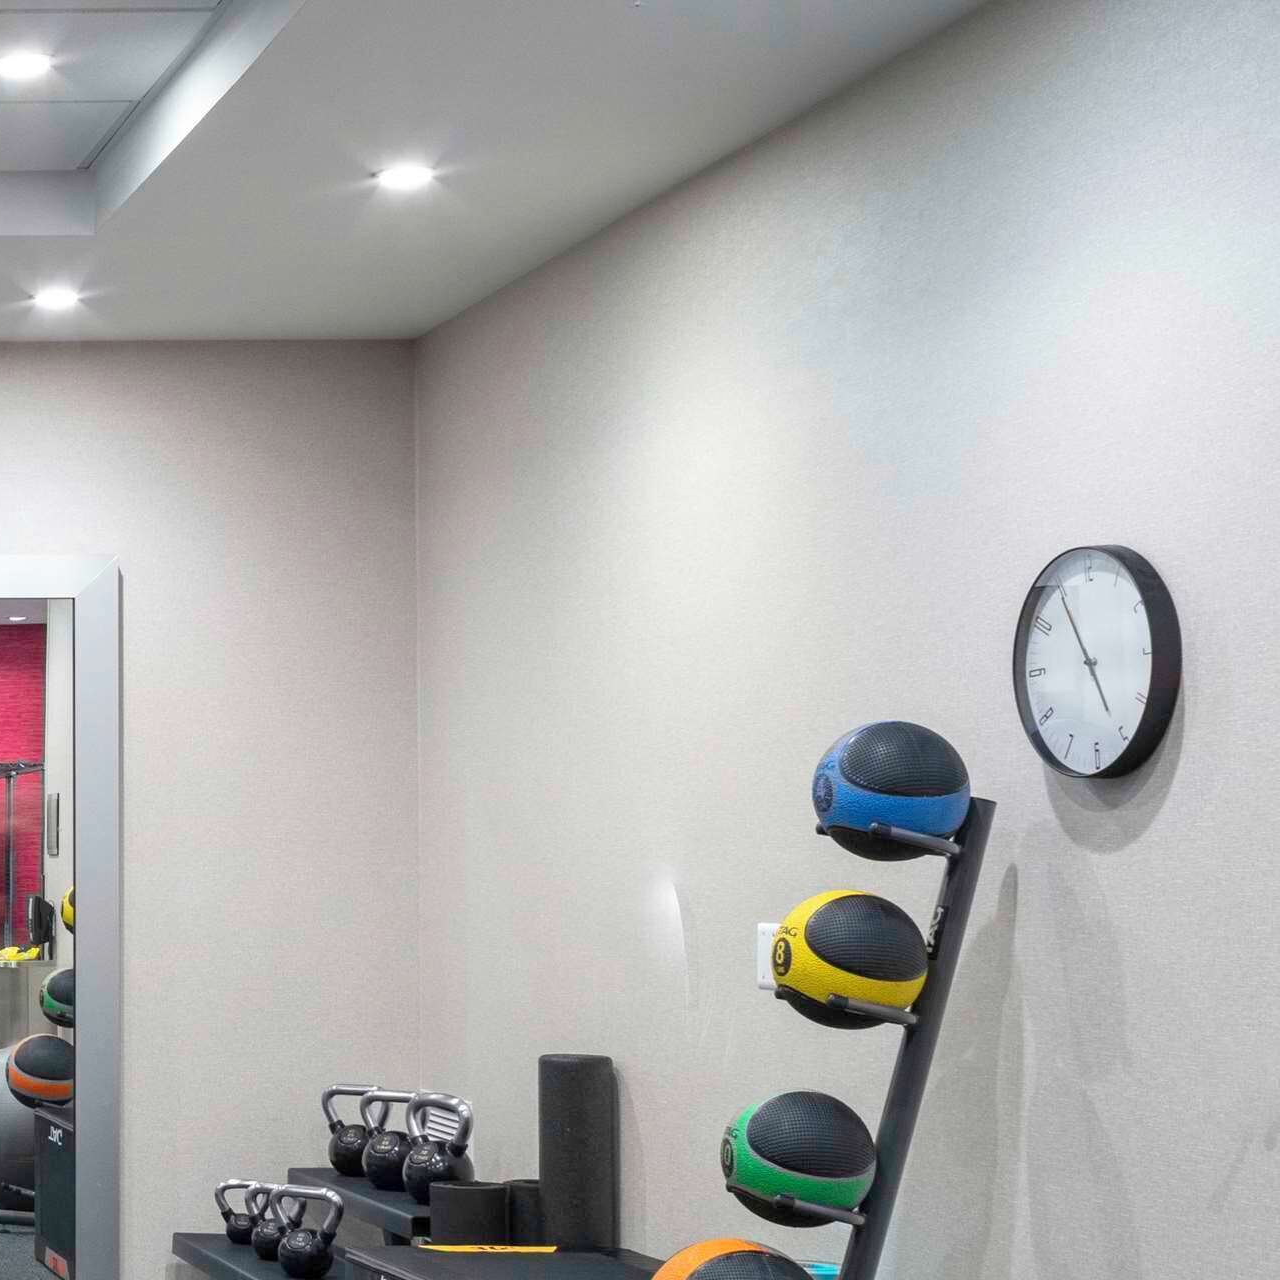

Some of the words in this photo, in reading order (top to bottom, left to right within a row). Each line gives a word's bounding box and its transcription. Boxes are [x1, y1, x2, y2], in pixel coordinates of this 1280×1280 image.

[1034, 616, 1052, 636] 10
[1040, 707, 1054, 726] 8
[1094, 742, 1101, 770] 6
[776, 941, 786, 964] 8
